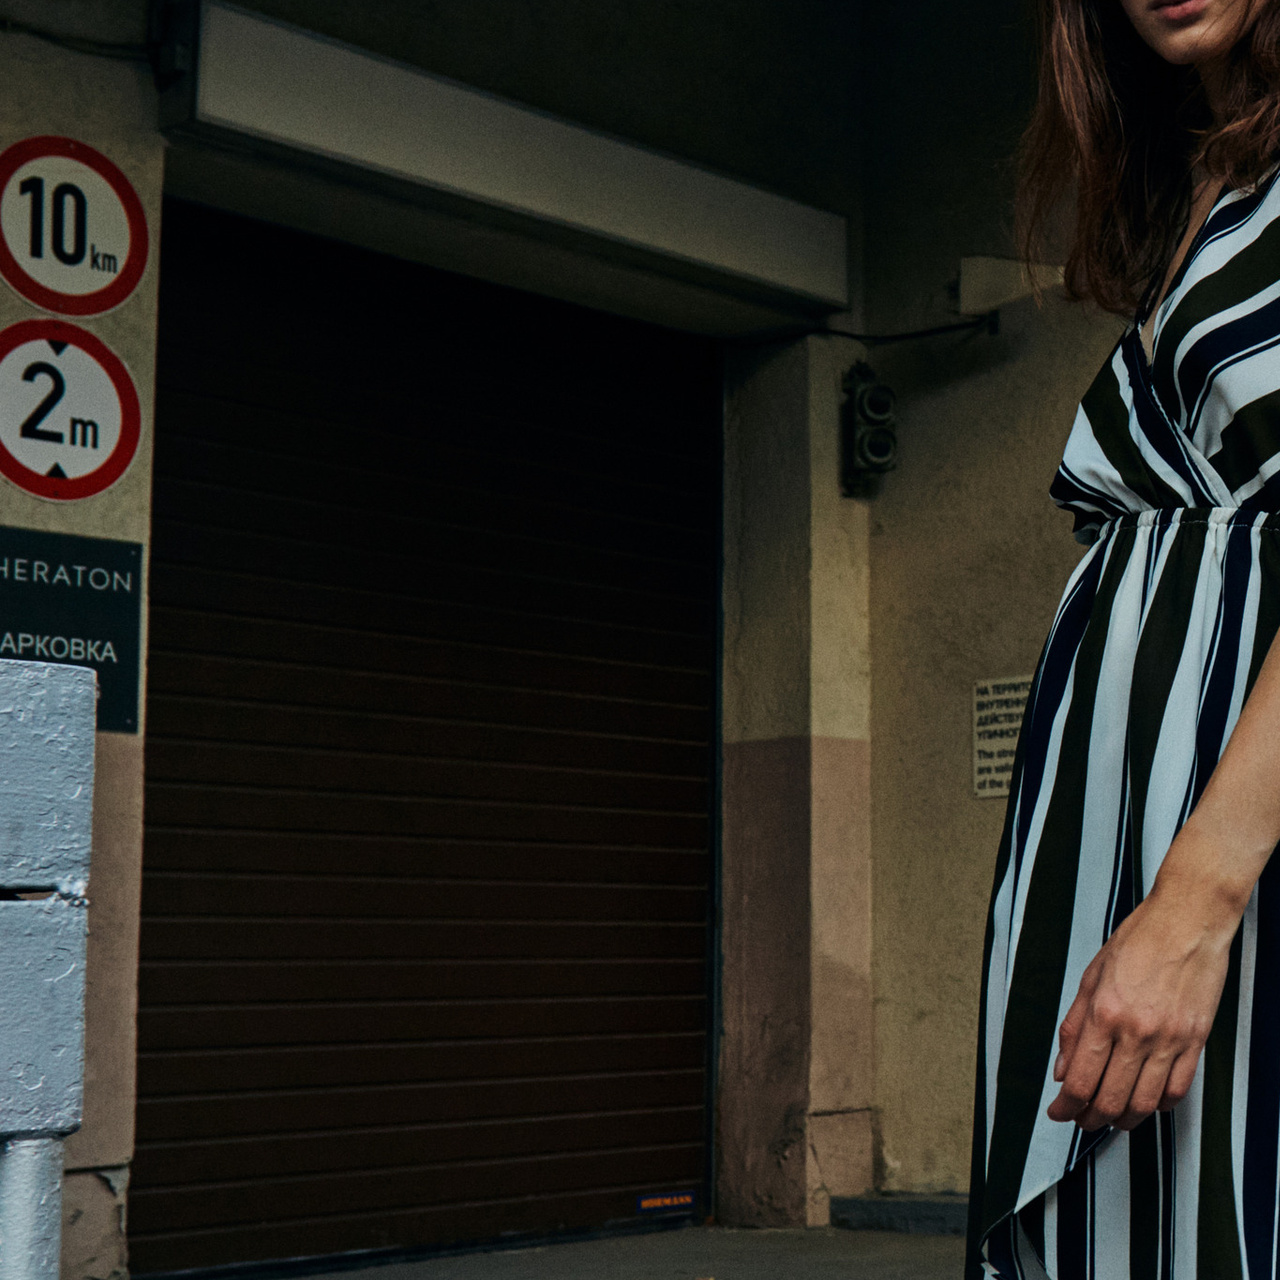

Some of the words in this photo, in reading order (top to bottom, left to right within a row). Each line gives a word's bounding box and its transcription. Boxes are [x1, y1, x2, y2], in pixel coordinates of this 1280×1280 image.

[19, 176, 87, 266] 10
[91, 243, 118, 274] km
[20, 361, 66, 444] 2
[69, 417, 99, 449] m
[0, 632, 118, 663] АРКОВКА
